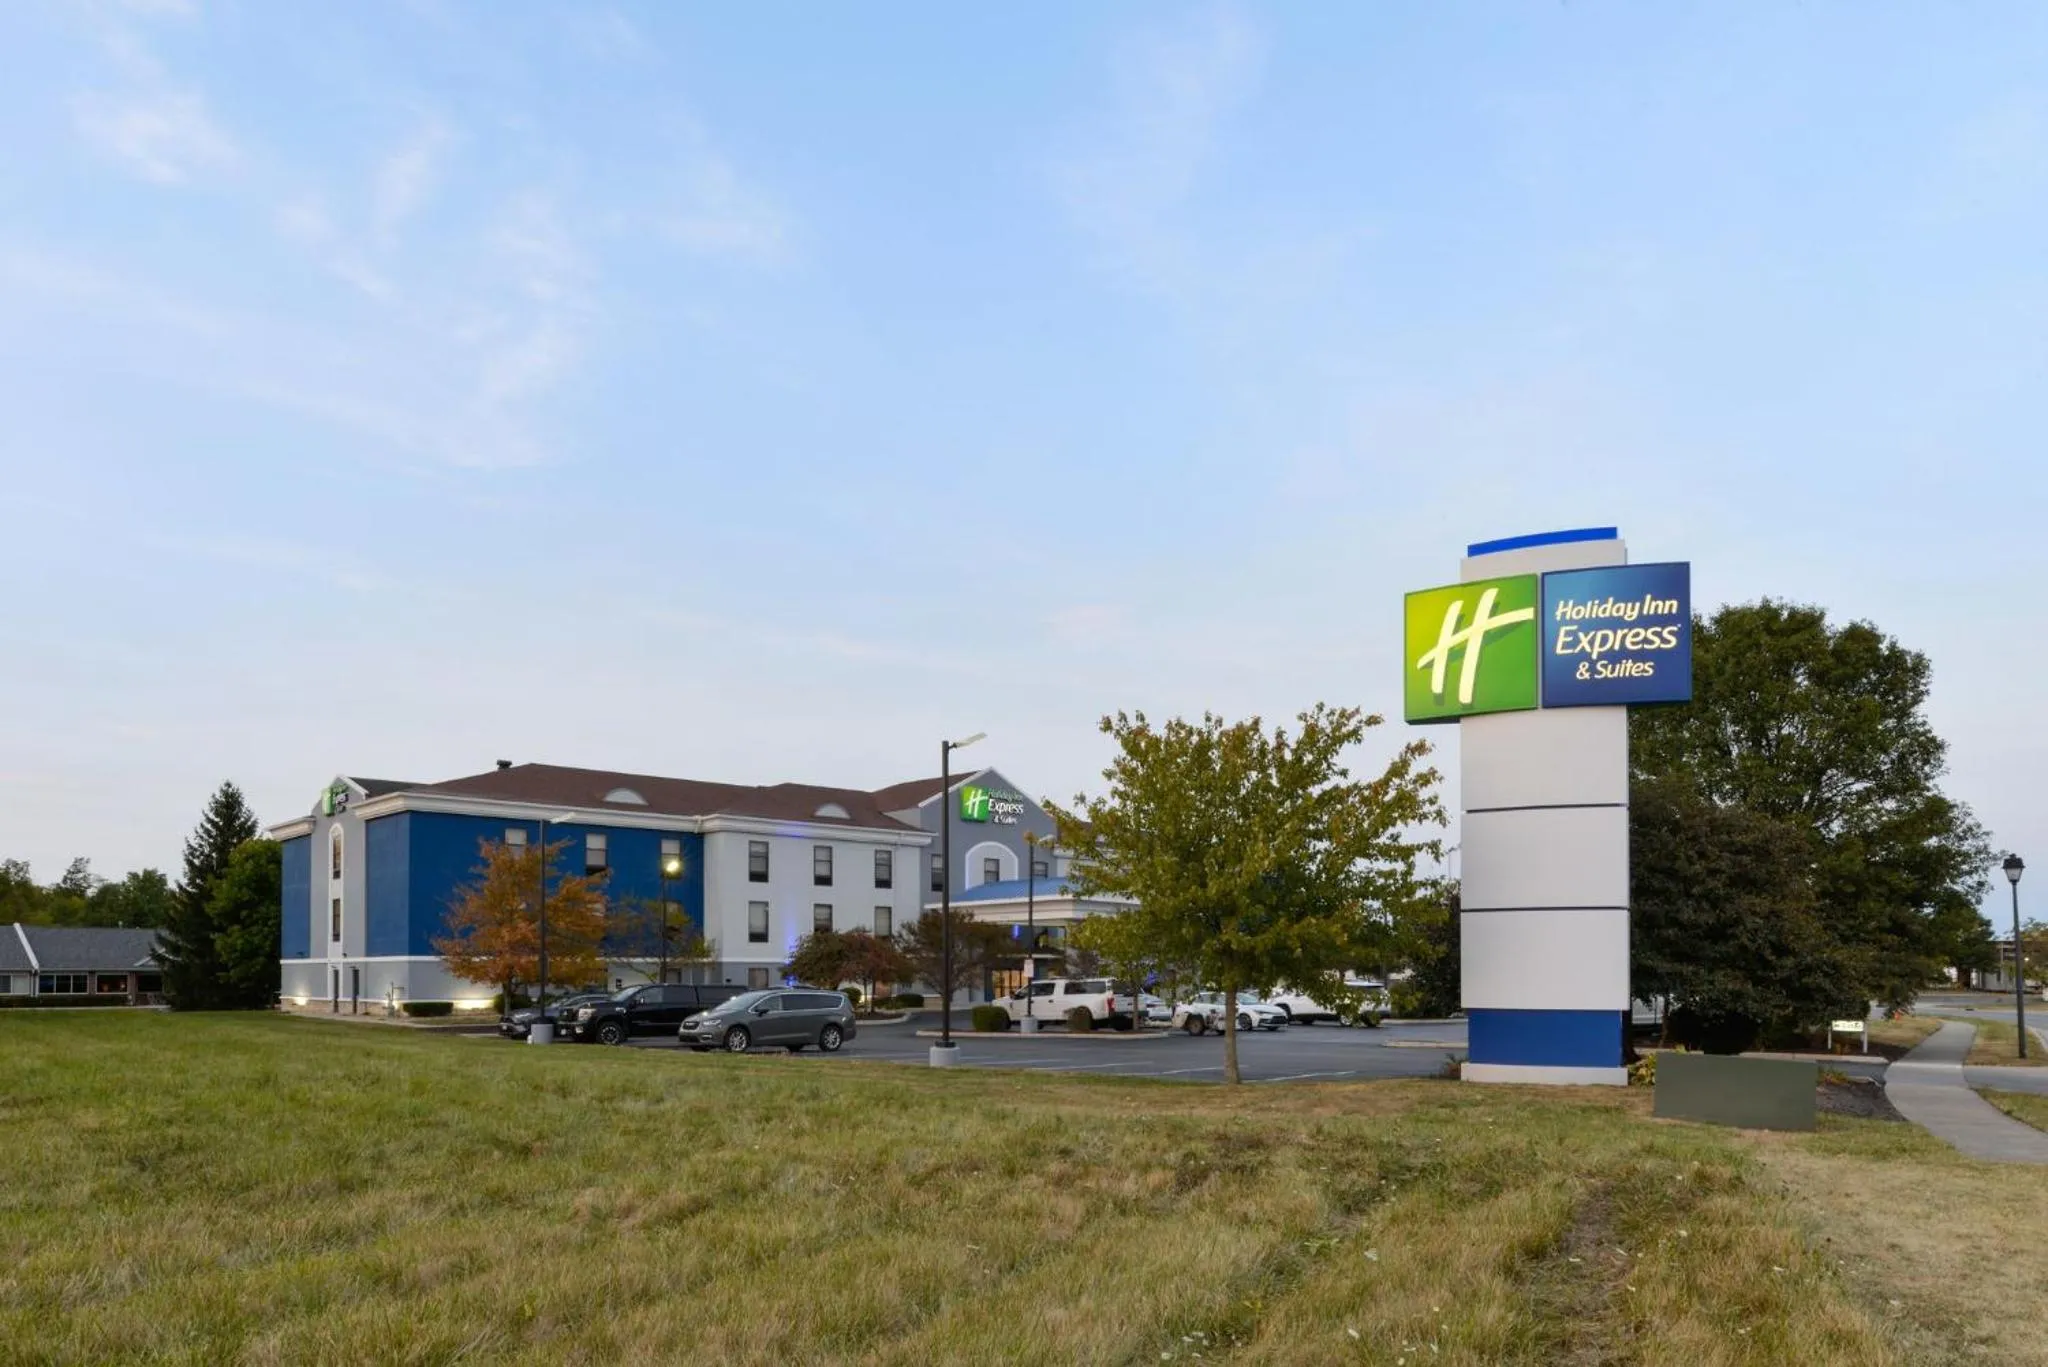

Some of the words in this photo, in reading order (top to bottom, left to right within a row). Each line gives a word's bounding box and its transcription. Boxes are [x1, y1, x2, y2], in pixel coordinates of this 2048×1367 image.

[1555, 597, 1640, 621] Holiday
[1643, 595, 1678, 616] Inn
[1417, 588, 1534, 704] H
[1556, 625, 1678, 659] Express
[1576, 661, 1591, 680] &
[1594, 659, 1654, 679] Suites
[988, 799, 1024, 815] Express
